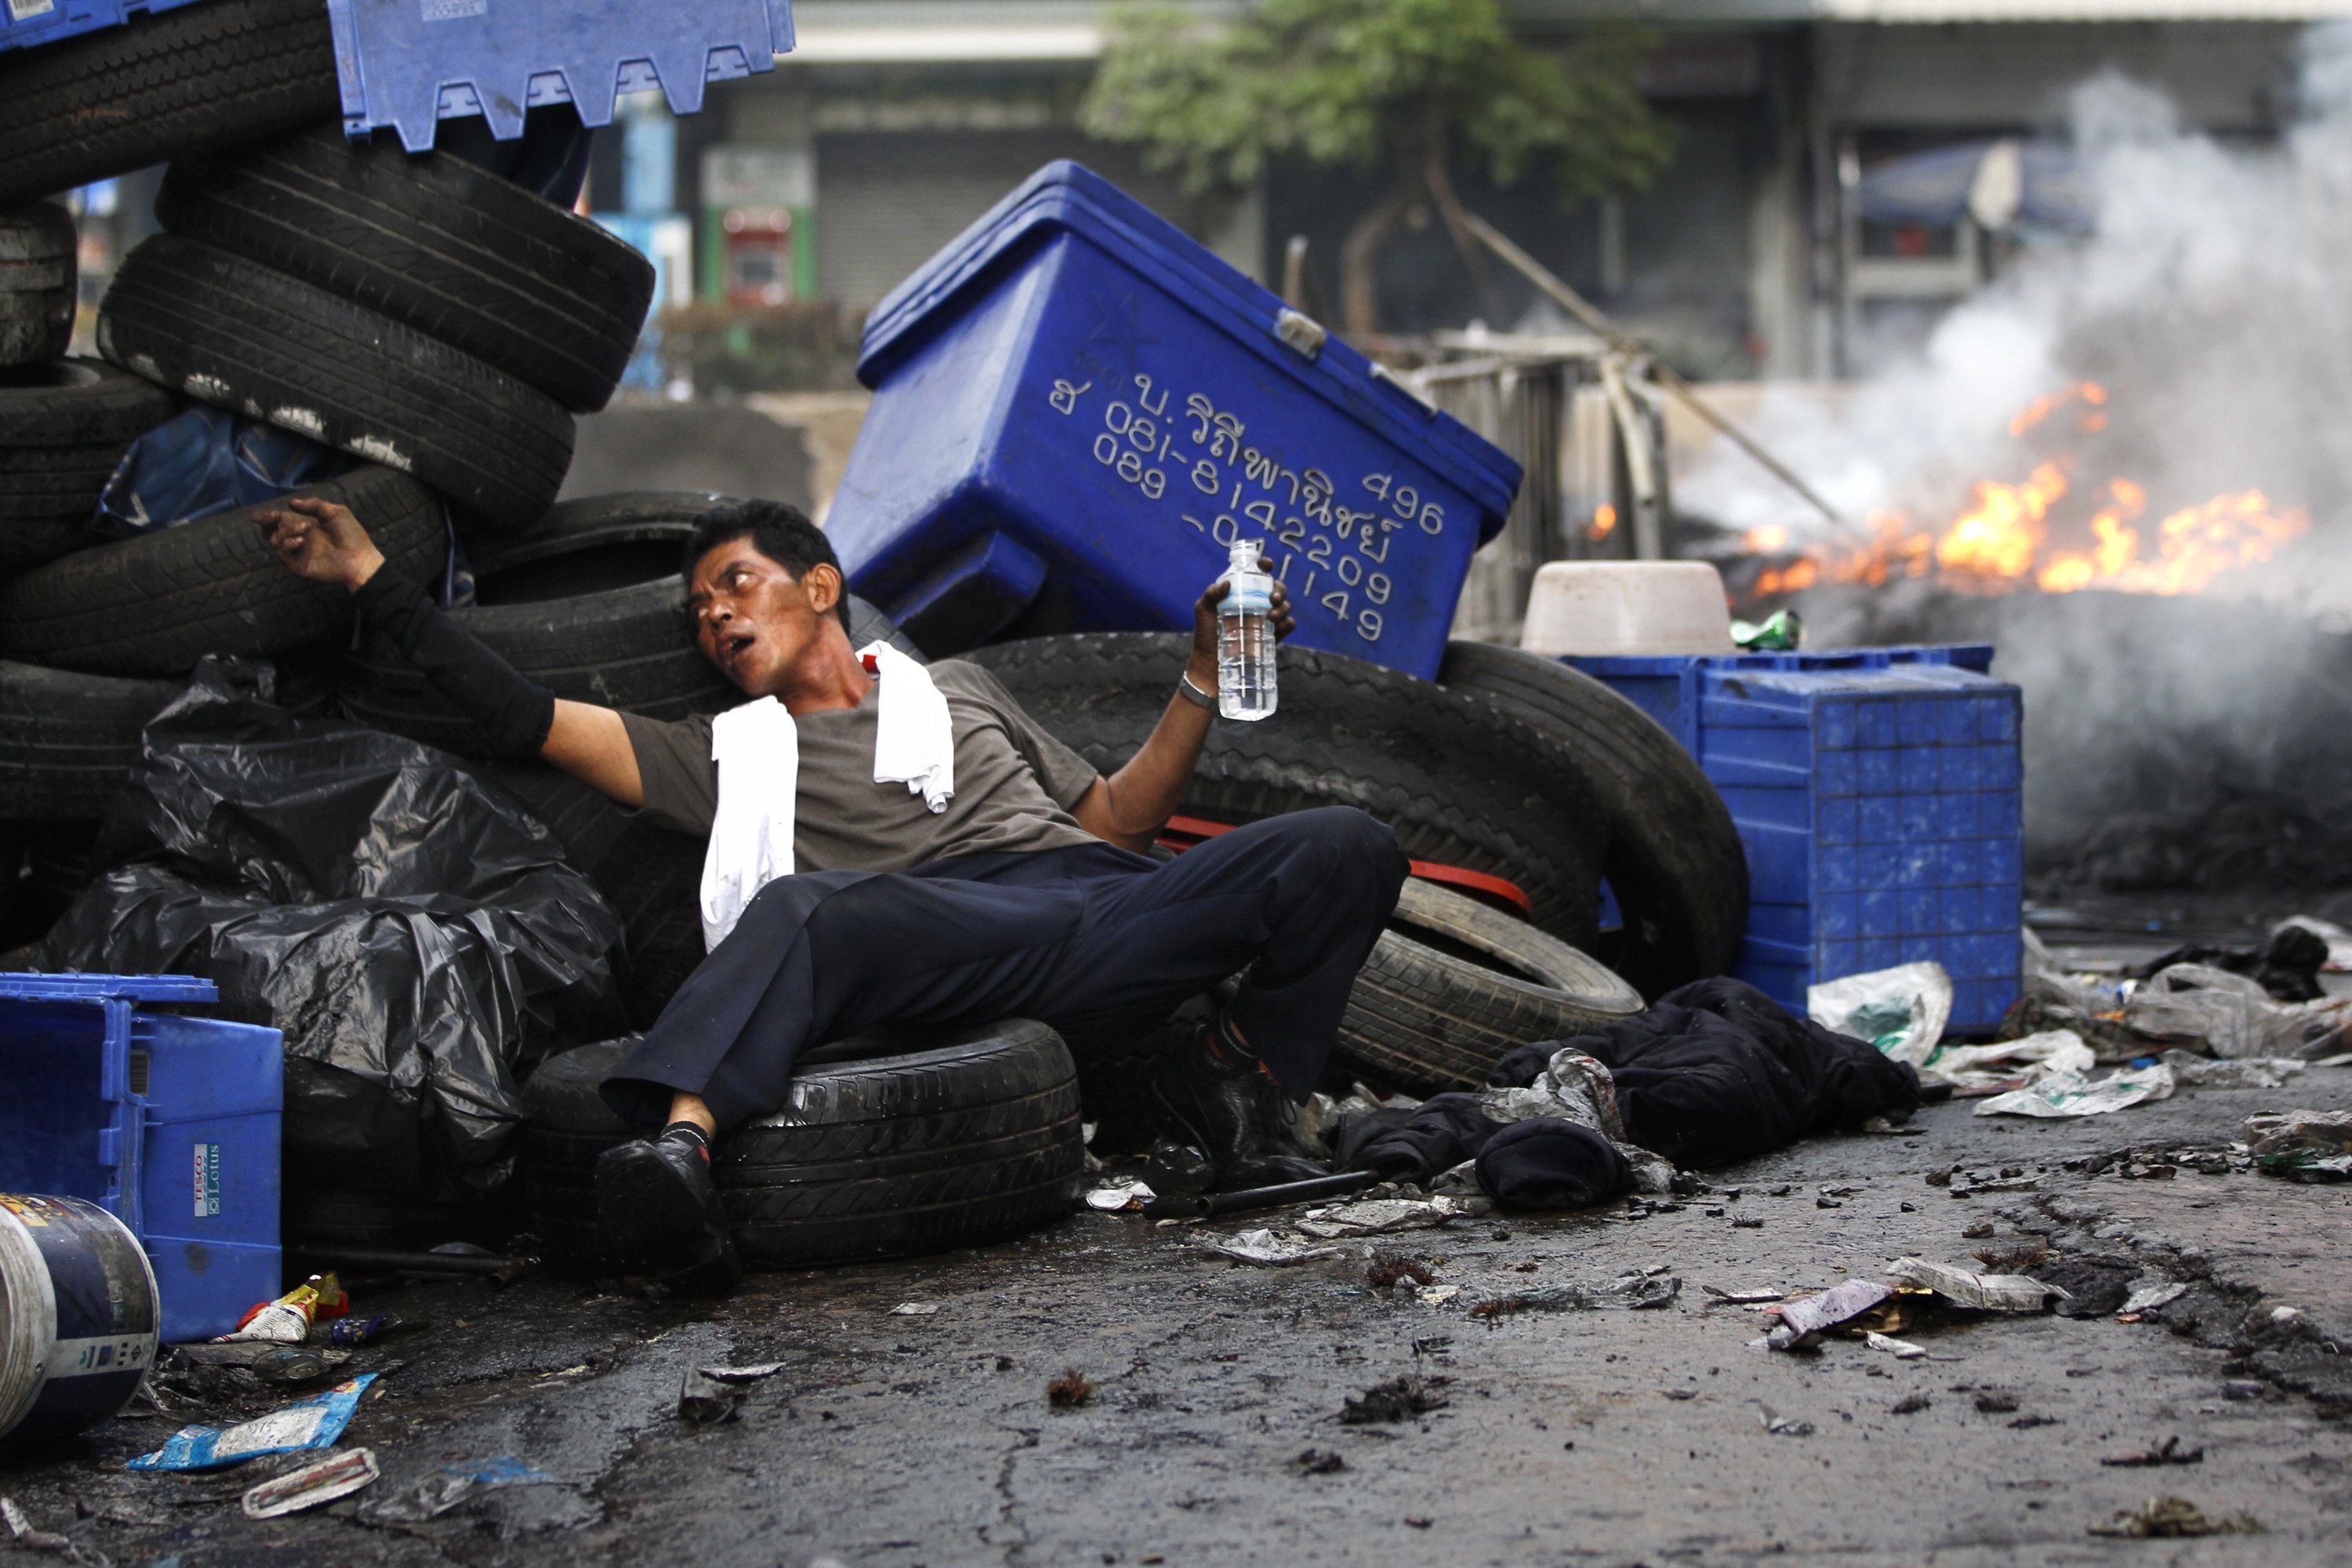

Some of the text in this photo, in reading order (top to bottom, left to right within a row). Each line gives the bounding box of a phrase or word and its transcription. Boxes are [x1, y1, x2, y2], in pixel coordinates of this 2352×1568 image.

[1105, 401, 1392, 605] 081-8142209
[1363, 473, 1446, 535] 496
[209, 1145, 220, 1194] Lotus
